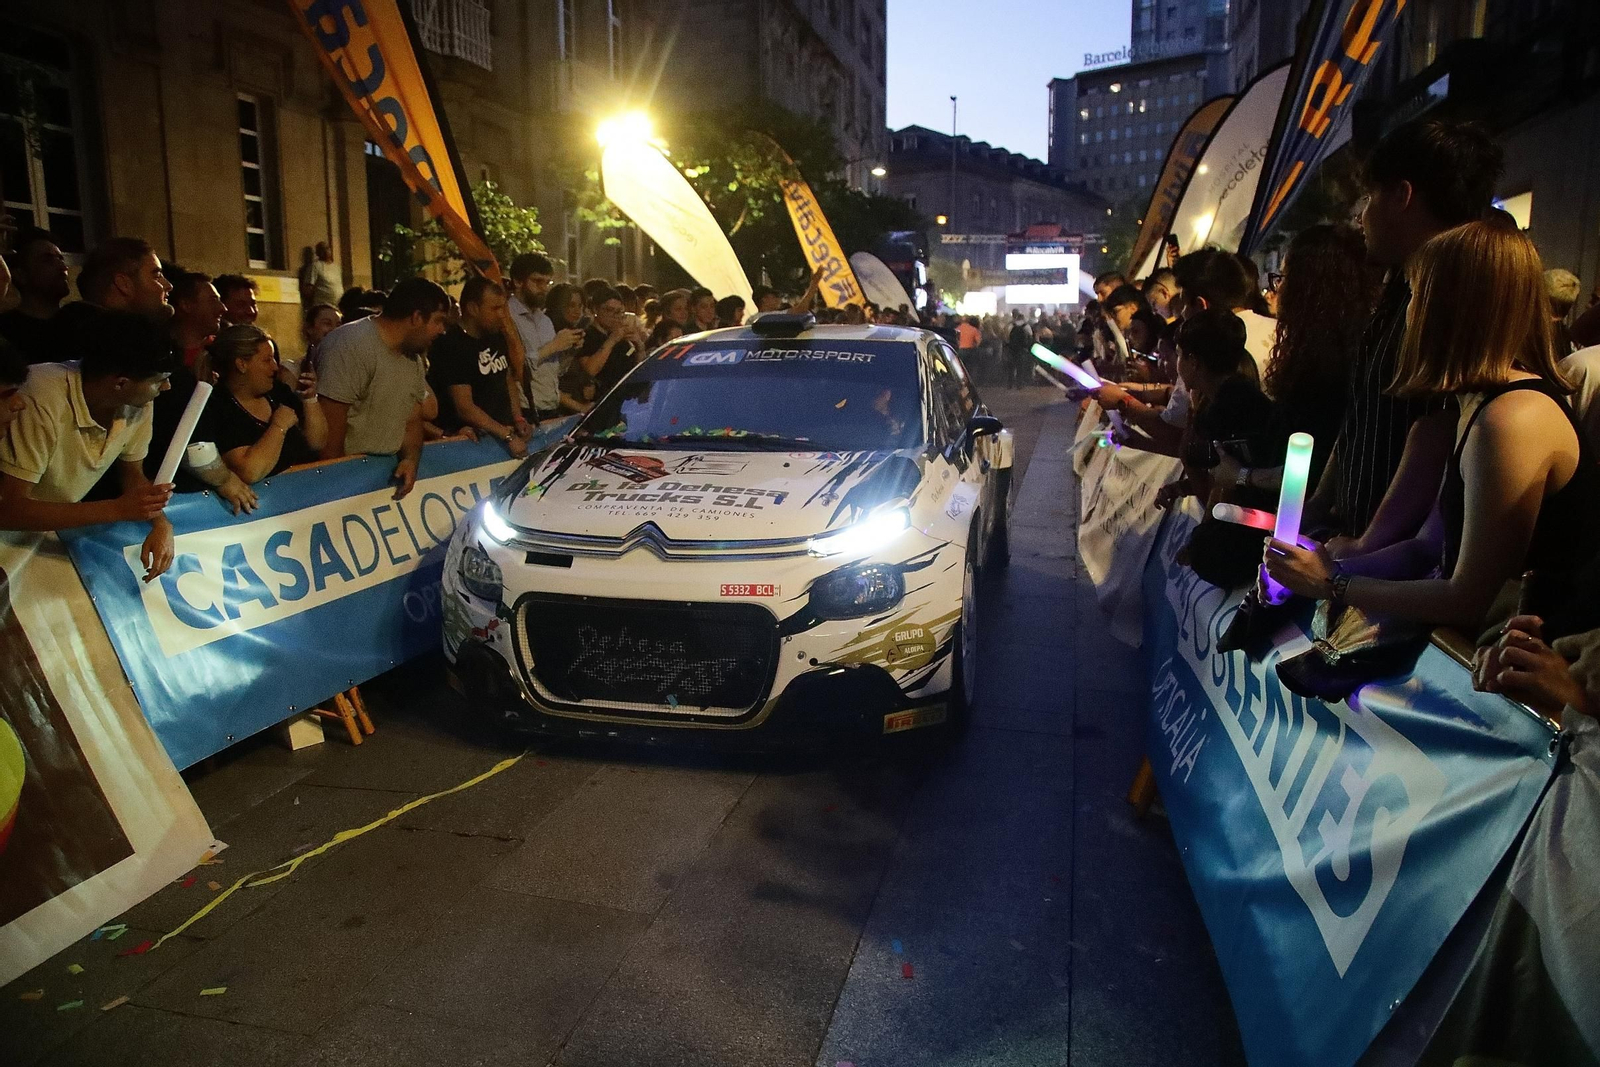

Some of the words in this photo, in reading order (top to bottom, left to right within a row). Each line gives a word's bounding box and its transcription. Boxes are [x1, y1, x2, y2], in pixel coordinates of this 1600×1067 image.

[658, 344, 695, 360] 11
[746, 349, 876, 363] MOTORSPORT
[617, 481, 648, 491] la
[657, 482, 789, 499] Dehesa
[583, 491, 704, 505] Trucks
[577, 503, 663, 512] COMPRAVENTA
[692, 508, 756, 519] CAMIONES
[728, 585, 750, 595] 5332
[756, 585, 773, 595] BCL
[895, 628, 924, 642] GRUPO
